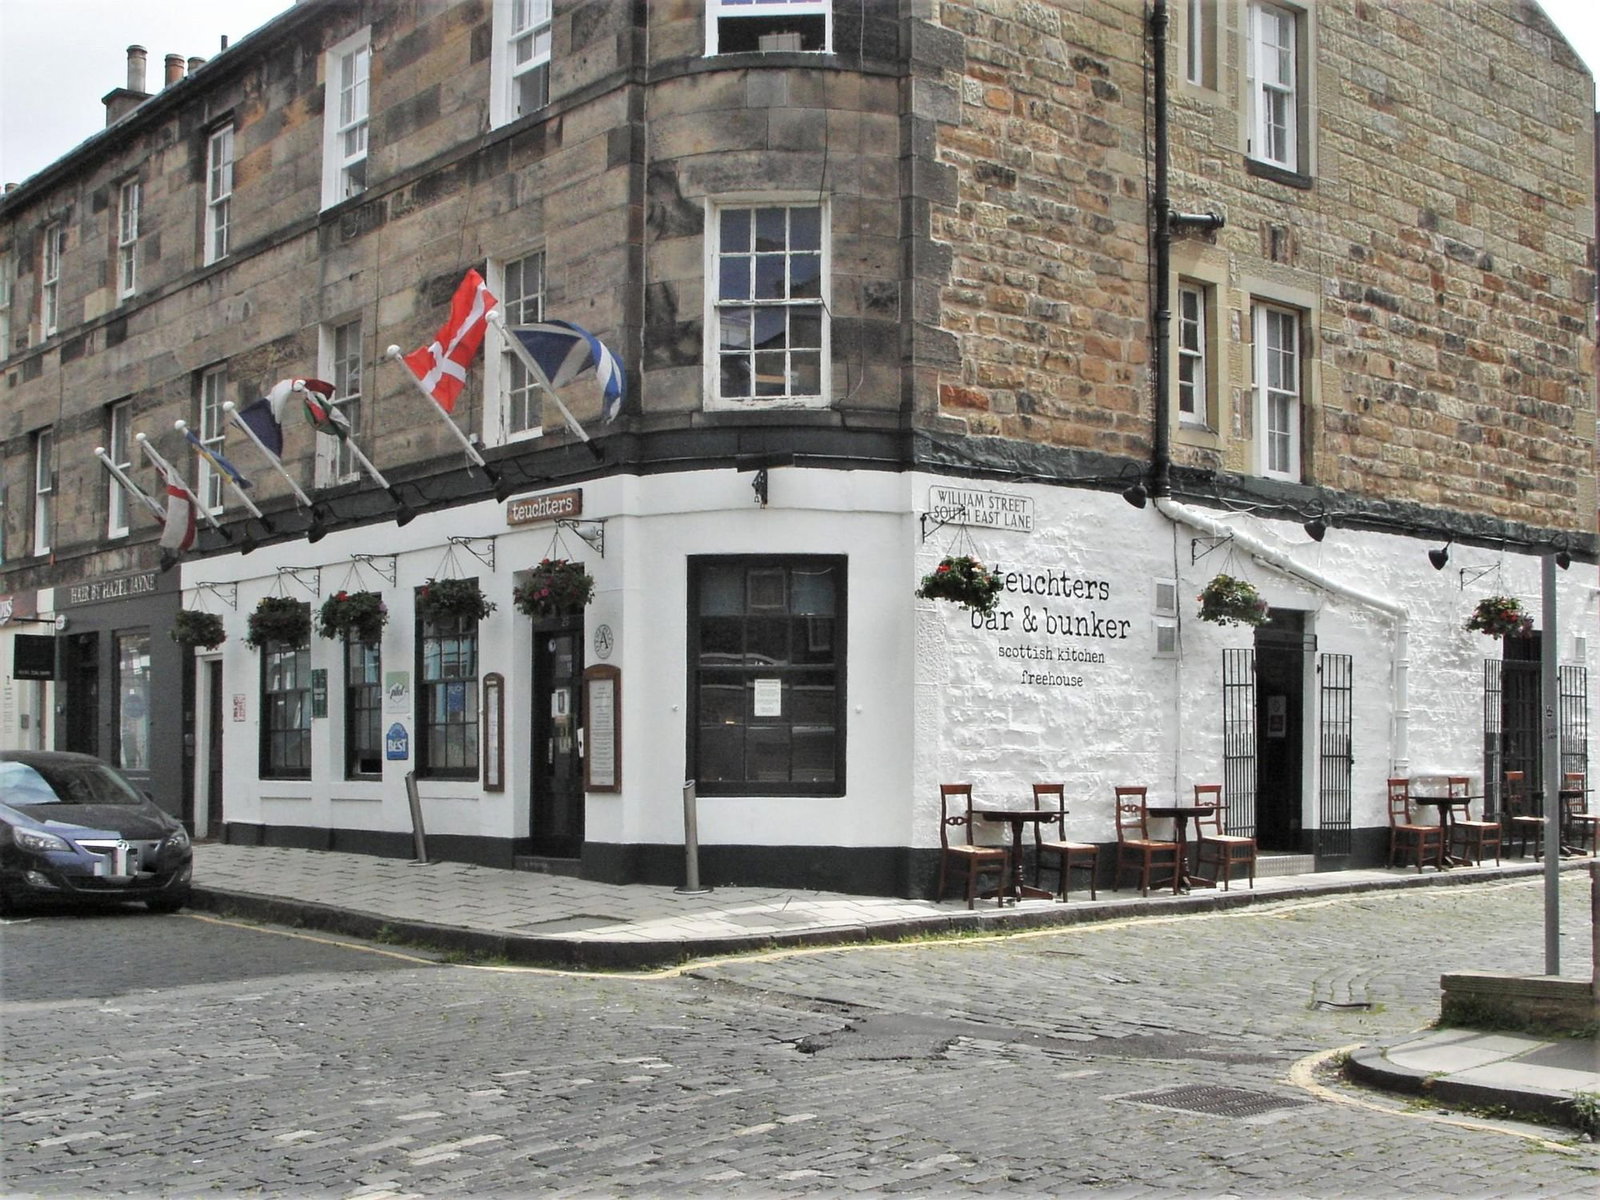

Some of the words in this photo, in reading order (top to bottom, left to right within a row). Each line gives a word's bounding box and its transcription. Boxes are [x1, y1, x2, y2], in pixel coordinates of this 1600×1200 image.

[512, 497, 573, 520] teuchters
[938, 490, 984, 508] WILLIAM
[989, 496, 1027, 513] STREET
[934, 505, 971, 522] SOUTH
[975, 509, 1000, 525] EAST
[1004, 512, 1031, 529] LANE
[71, 585, 90, 603] HAIR
[103, 579, 127, 599] HAZEL
[971, 605, 1014, 631] bar
[1022, 605, 1038, 633] &
[1043, 607, 1131, 639] bunker
[998, 645, 1053, 661] scottish
[1057, 648, 1105, 664] kitchen
[1021, 670, 1084, 687] freehouse
[387, 738, 407, 752] BEST
